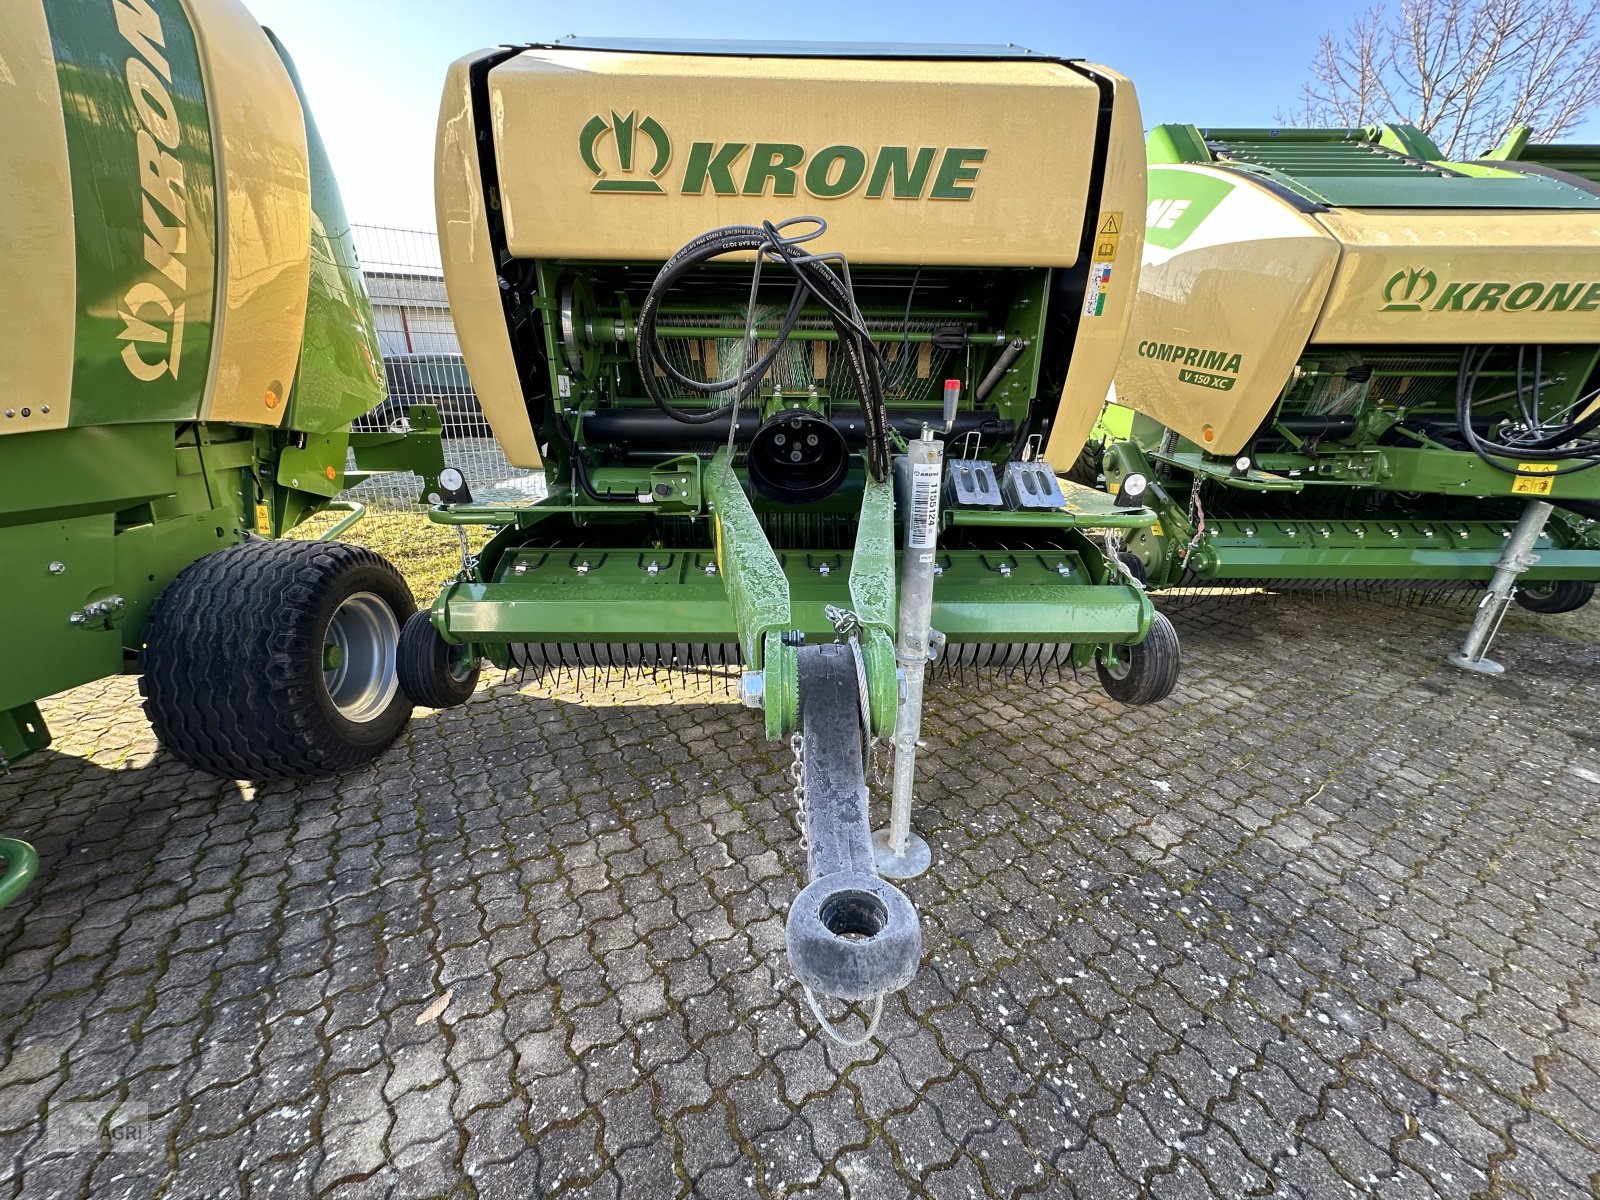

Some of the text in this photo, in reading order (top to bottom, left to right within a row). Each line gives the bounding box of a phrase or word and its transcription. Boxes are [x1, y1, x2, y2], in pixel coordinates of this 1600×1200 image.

[680, 141, 989, 202] KRONE
[1429, 281, 1600, 312] KRONE
[1138, 340, 1242, 373] COMPRIMA
[1184, 372, 1229, 389] V 150 XC
[927, 482, 938, 527] 1155124
